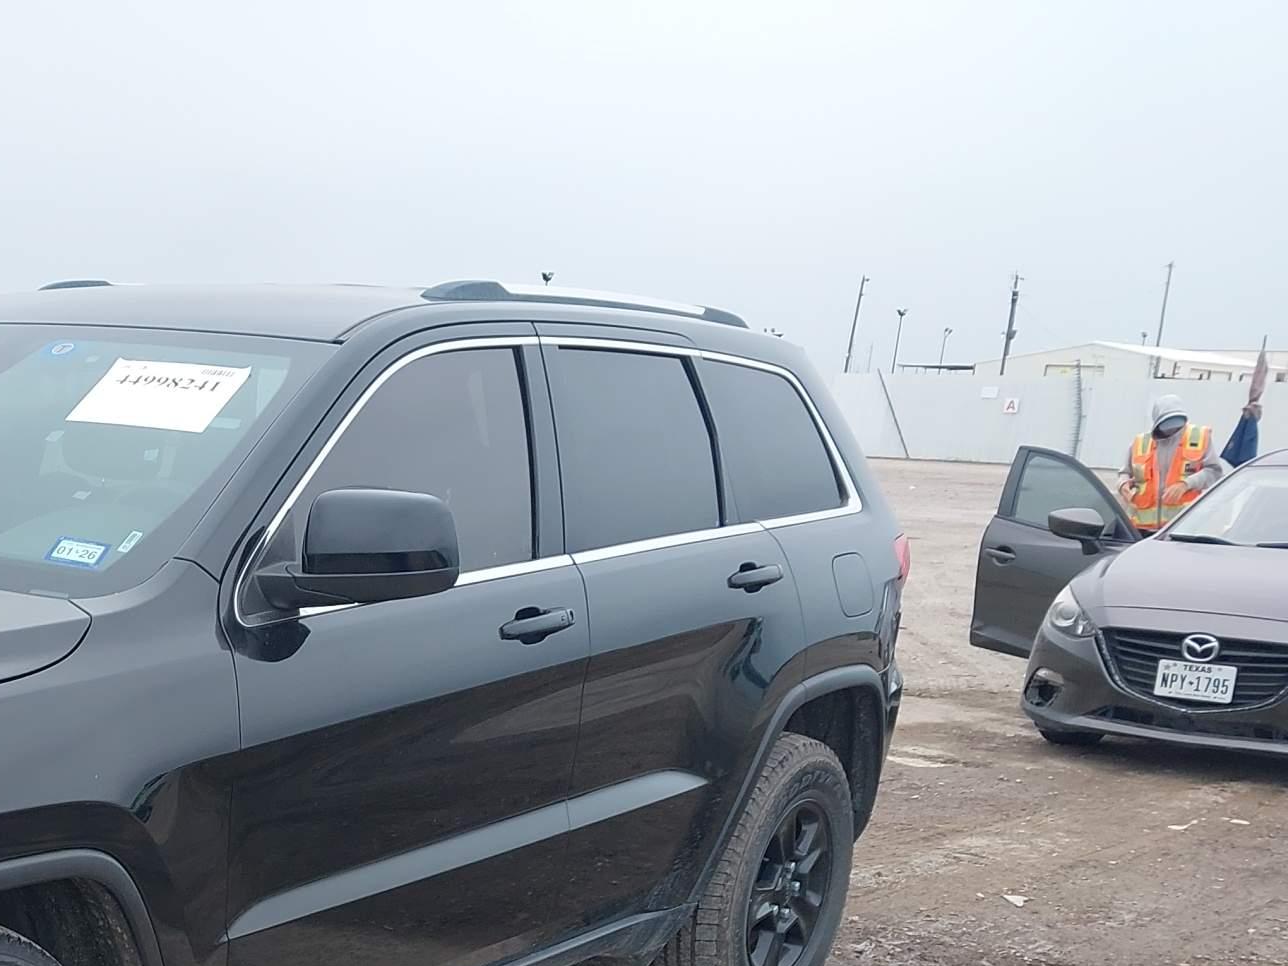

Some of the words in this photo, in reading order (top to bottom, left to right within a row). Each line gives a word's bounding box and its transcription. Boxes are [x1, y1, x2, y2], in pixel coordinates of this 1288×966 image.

[115, 374, 221, 392] 44998241
[1006, 399, 1017, 412] A
[1183, 663, 1213, 674] TEXAS
